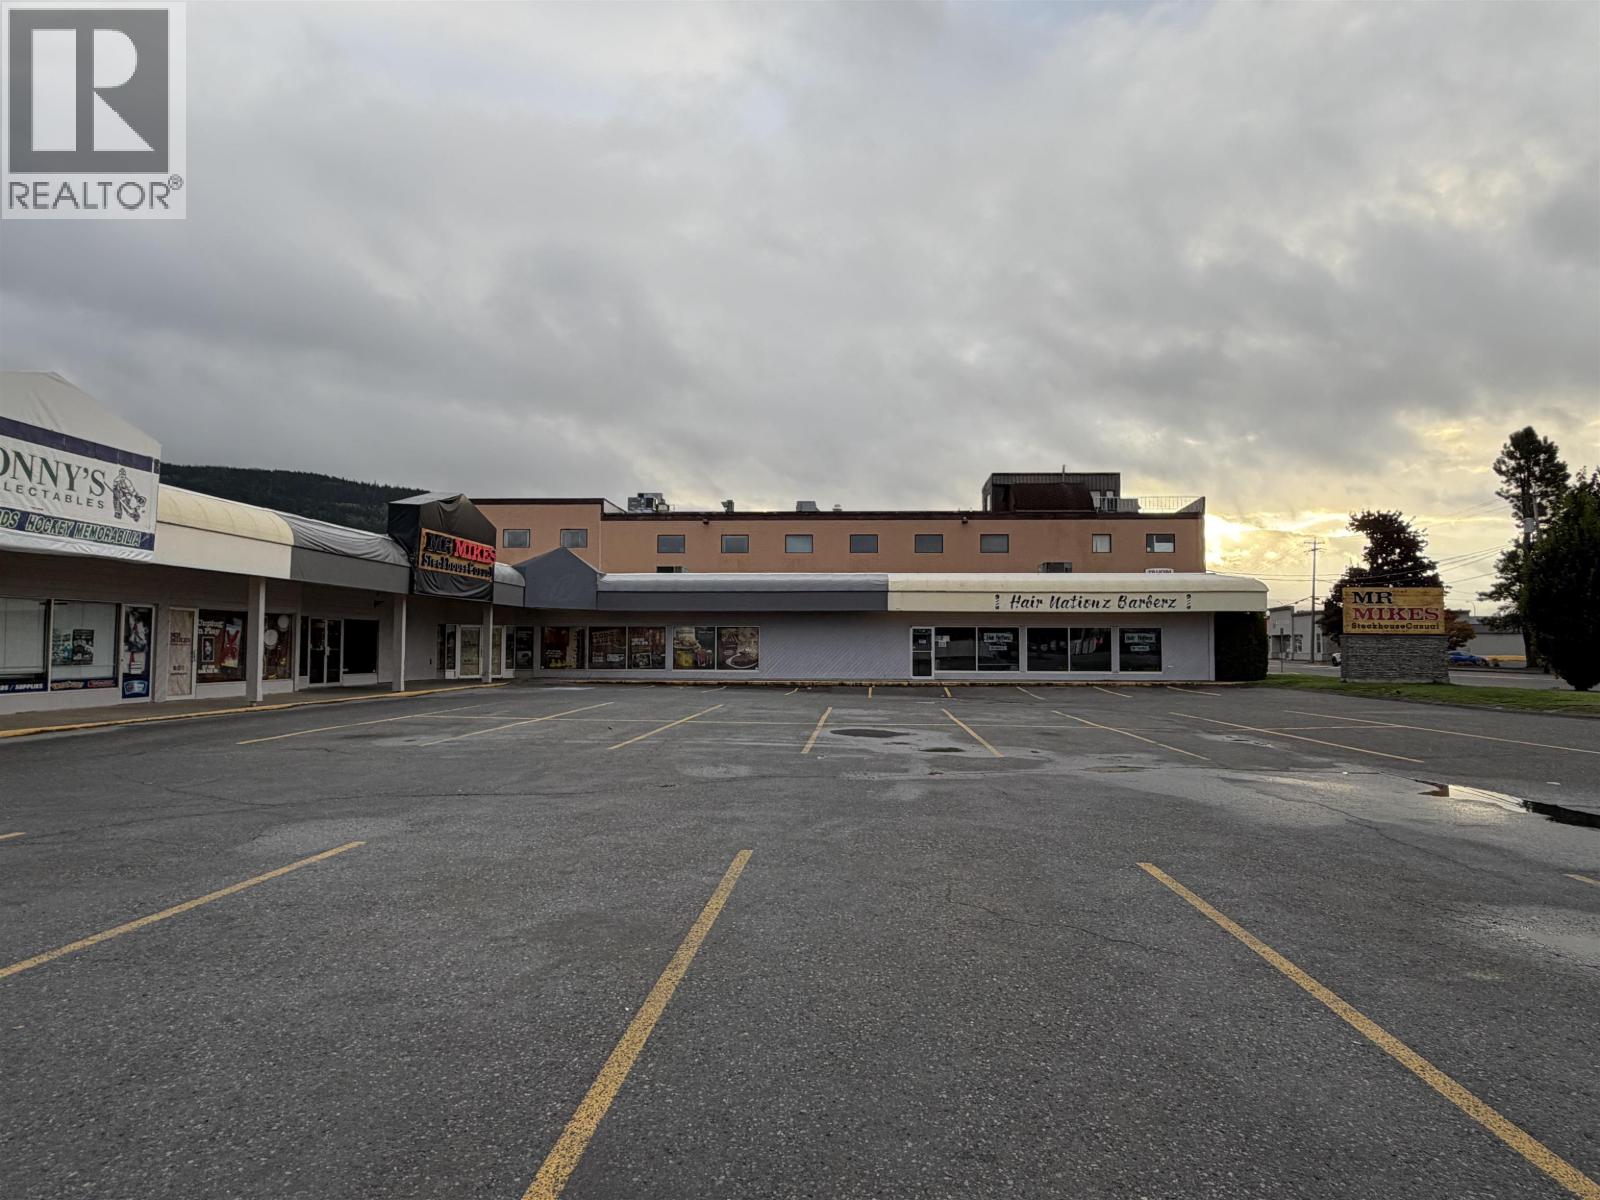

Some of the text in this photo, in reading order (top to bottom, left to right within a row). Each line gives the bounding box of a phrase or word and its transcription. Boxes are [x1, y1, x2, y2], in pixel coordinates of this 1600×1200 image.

[25, 513, 74, 537] HOCKEY
[73, 521, 142, 547] MEMORABILIA
[454, 537, 496, 564] MIKES
[1010, 594, 1043, 609] Hair
[1117, 594, 1177, 609] Barberz
[1351, 591, 1393, 604] MR
[1352, 607, 1440, 621] MIKES
